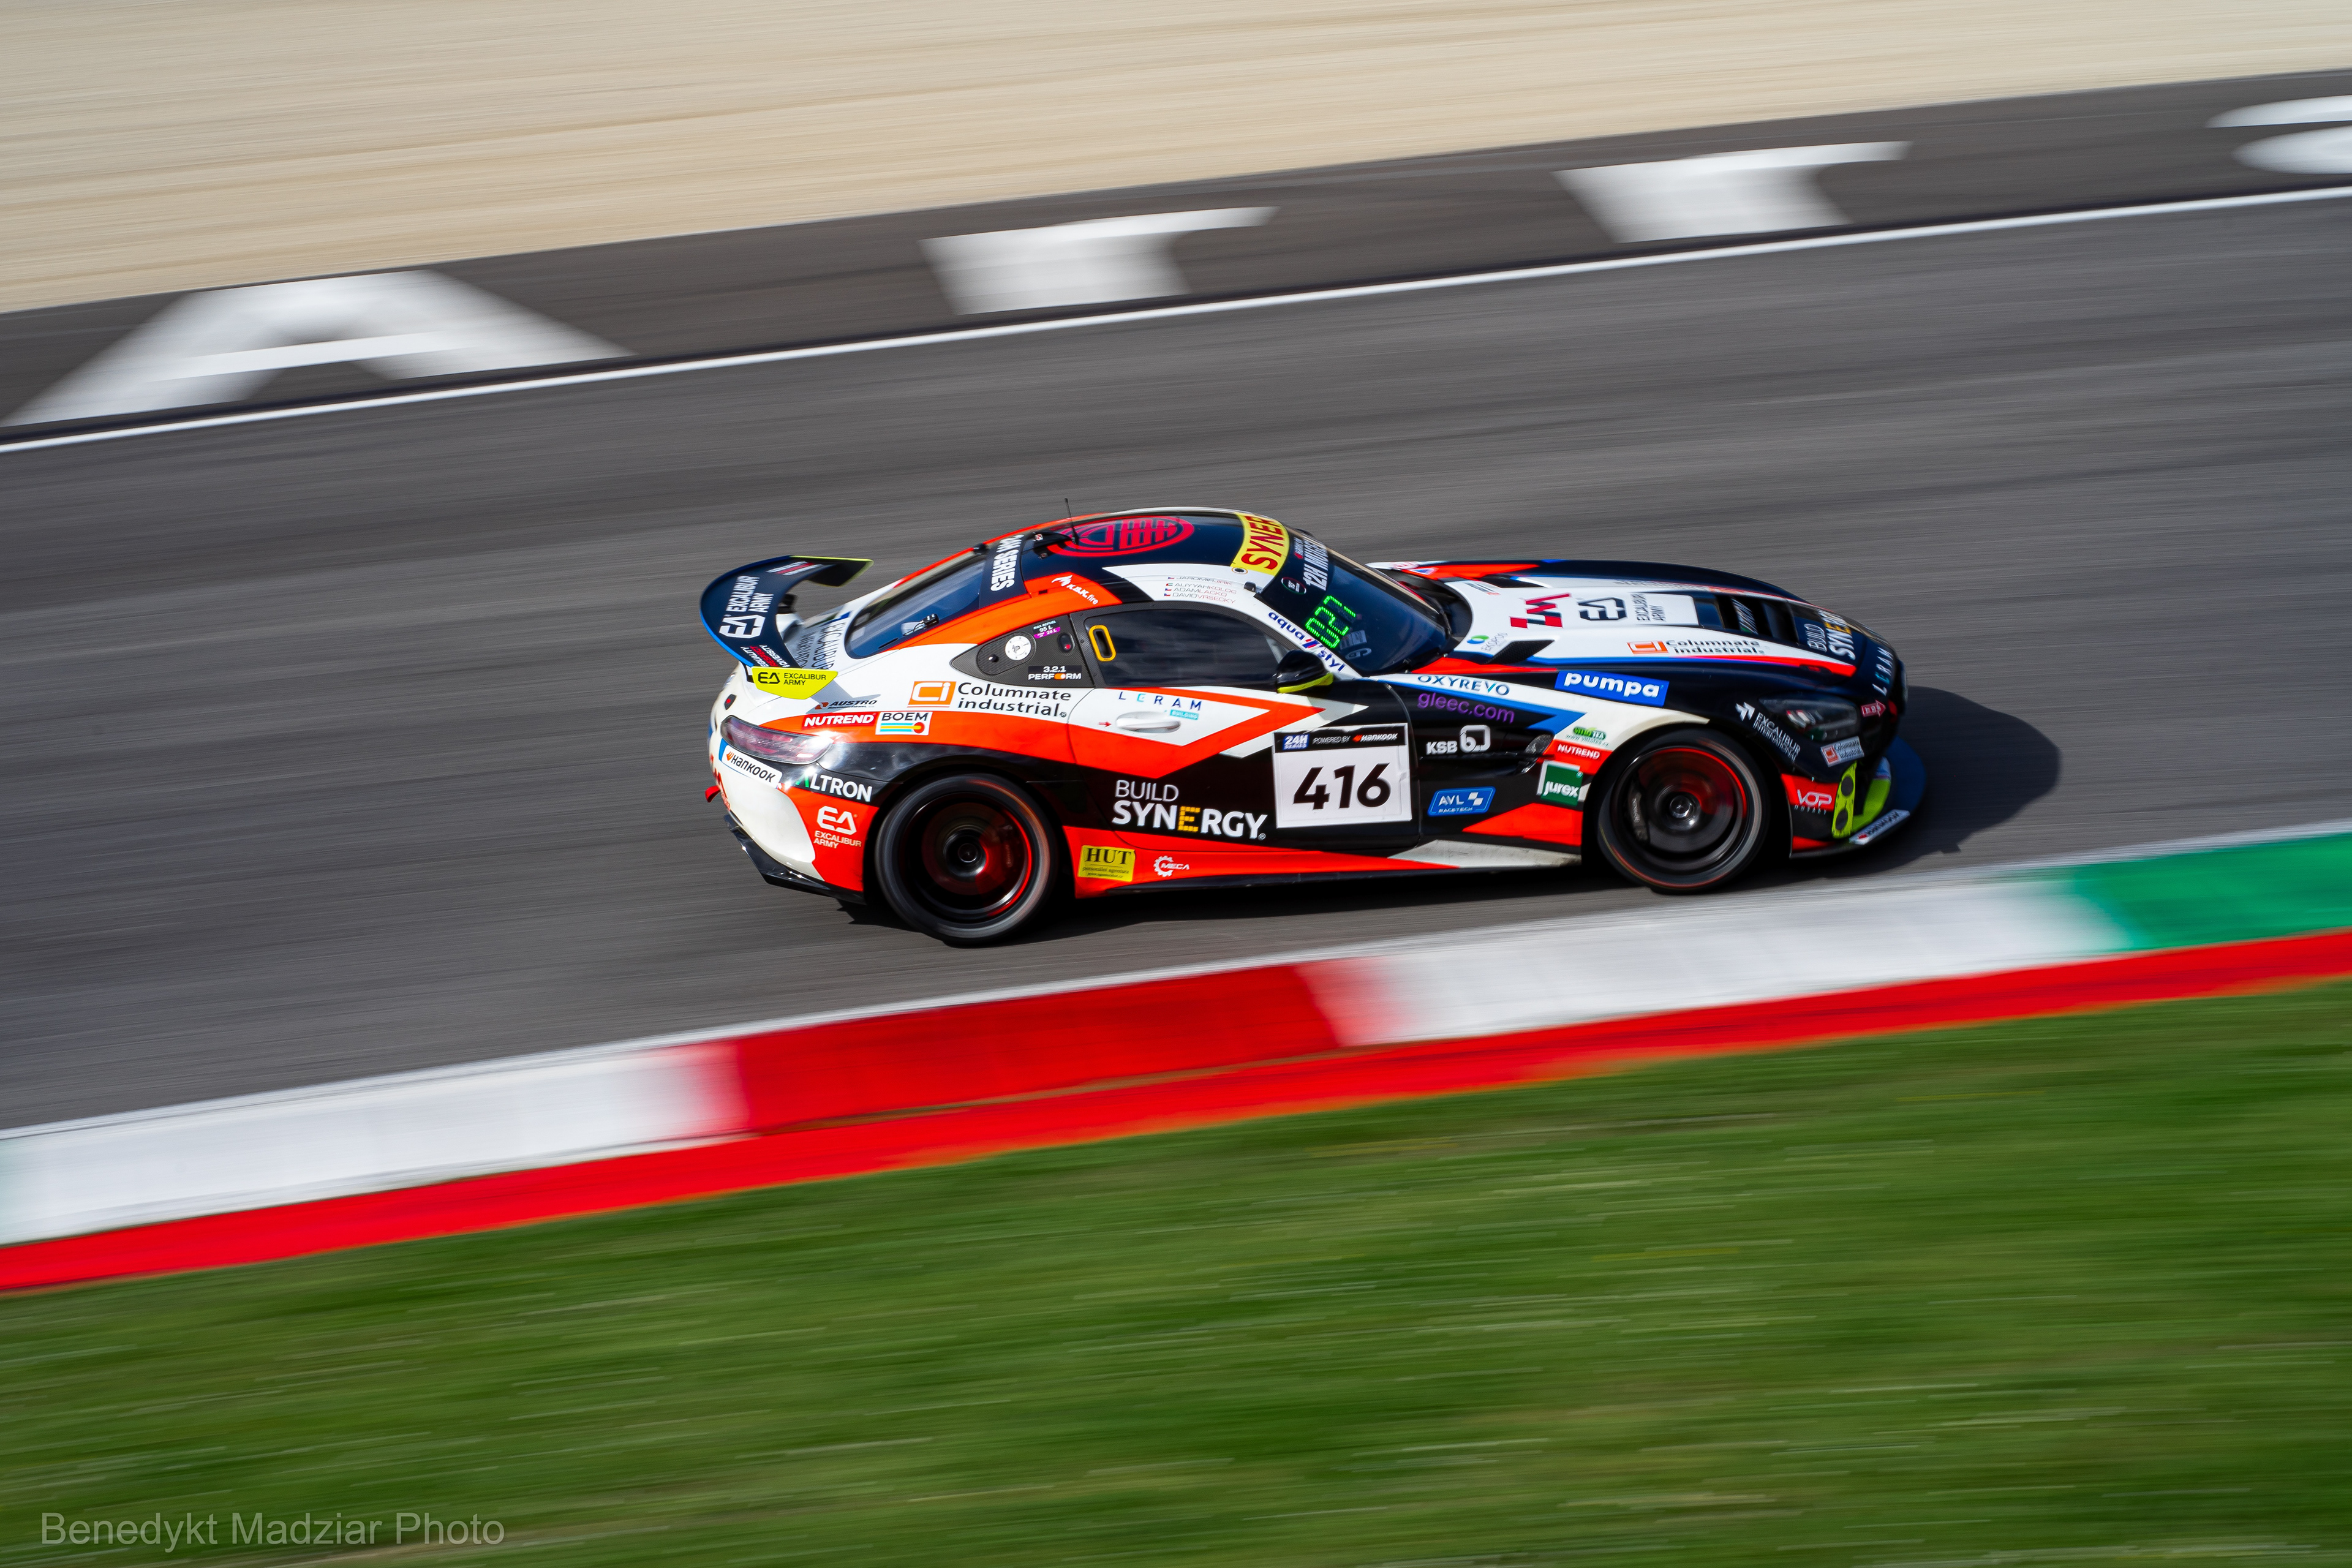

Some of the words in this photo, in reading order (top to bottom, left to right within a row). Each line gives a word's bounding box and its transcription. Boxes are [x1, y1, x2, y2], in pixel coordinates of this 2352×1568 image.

[990, 549, 1019, 591] SERIES
[1303, 564, 1328, 591] 12H
[725, 575, 760, 612] EXCALIBUR
[748, 592, 774, 612] ARMY
[1631, 593, 1651, 622] EXCALIBUR
[1649, 605, 1666, 622] ARMY
[1268, 611, 1306, 641] aqua
[1666, 639, 1760, 648] Columnate
[1673, 645, 1759, 655] industrial
[741, 646, 770, 667] EQUALITY
[958, 682, 1071, 701] Columnate
[1417, 674, 1510, 696] OXYREVO
[1564, 673, 1660, 698] pumpa
[958, 698, 1060, 717] industrial
[1118, 692, 1202, 711] LERAM
[1417, 692, 1515, 724] gleec.com
[804, 714, 875, 728] NUTREND
[881, 712, 928, 722] BOEM
[1285, 735, 1308, 745] 24H
[1755, 712, 1801, 756] EXCALIBUR
[1427, 741, 1457, 755] KSB
[1558, 744, 1600, 760] NUTREND
[1115, 780, 1179, 802] BUILD
[1293, 763, 1391, 810] 416
[1543, 781, 1580, 798] jurex
[1439, 795, 1464, 806] AVL
[1112, 800, 1267, 839] SYNERGY
[813, 838, 839, 849] ARMY
[814, 830, 862, 847] EXCALIBUR
[1085, 848, 1132, 865] HUT
